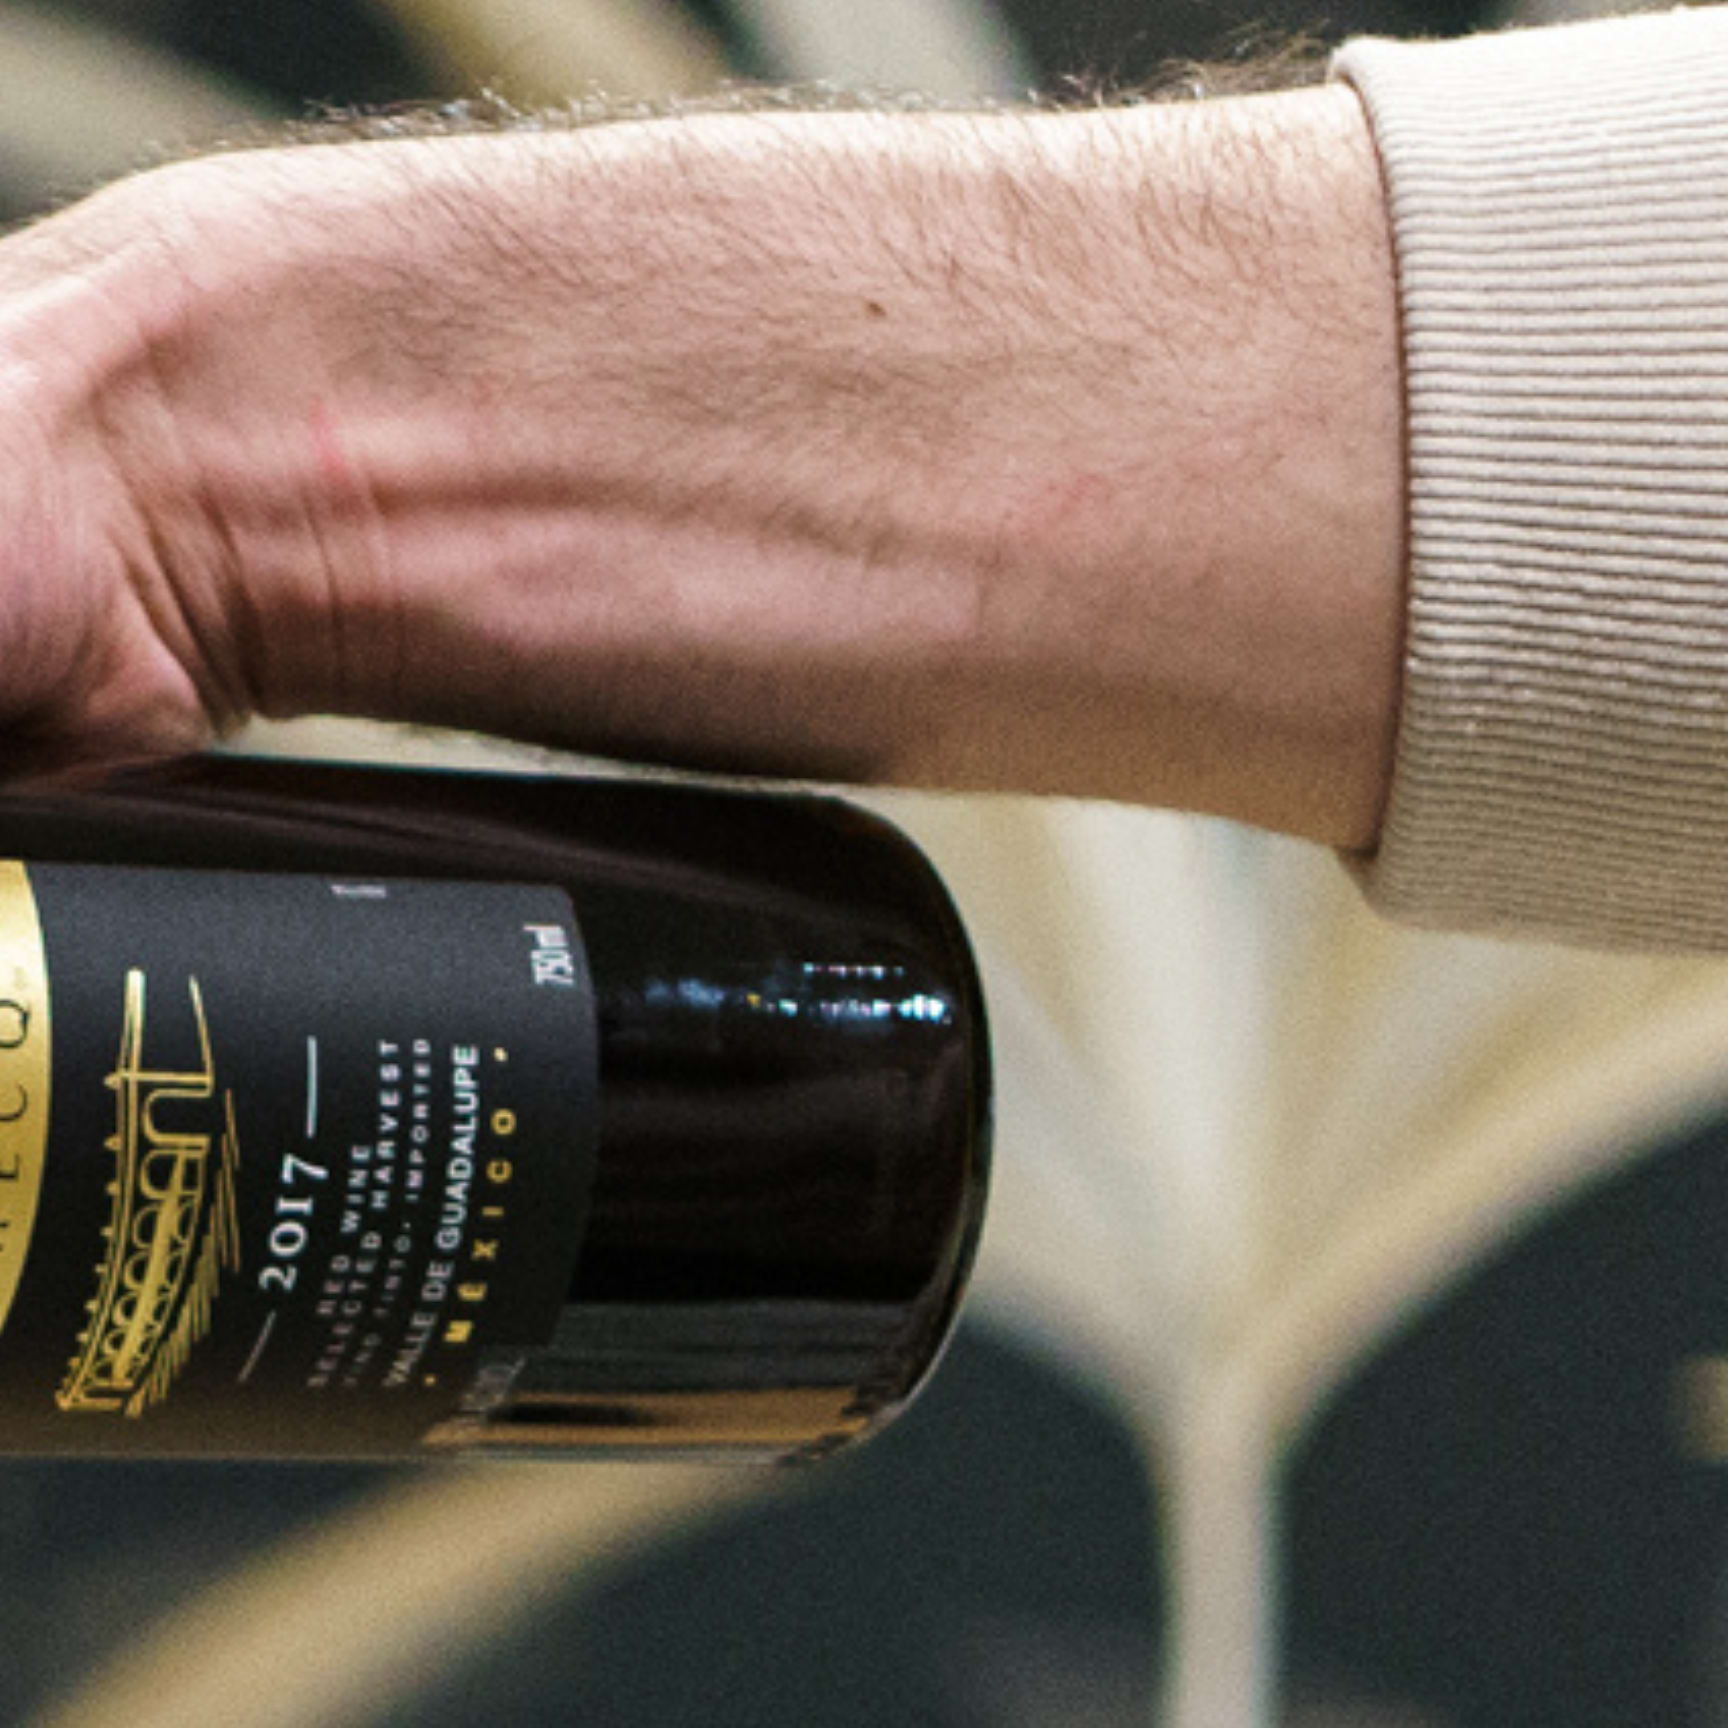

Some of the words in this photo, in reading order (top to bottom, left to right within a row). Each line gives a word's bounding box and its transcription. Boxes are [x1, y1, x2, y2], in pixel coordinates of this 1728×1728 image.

[404, 1038, 432, 1202] IMPORTED
[436, 1044, 480, 1250] GUADALUPE
[258, 1152, 329, 1291] 2017
[307, 1230, 383, 1388] SELECTED
[371, 1038, 400, 1210] HARVEST
[316, 1253, 351, 1316] RED
[339, 1144, 372, 1234] WINE
[421, 1259, 455, 1301] DE
[381, 1311, 438, 1388] VALLE
